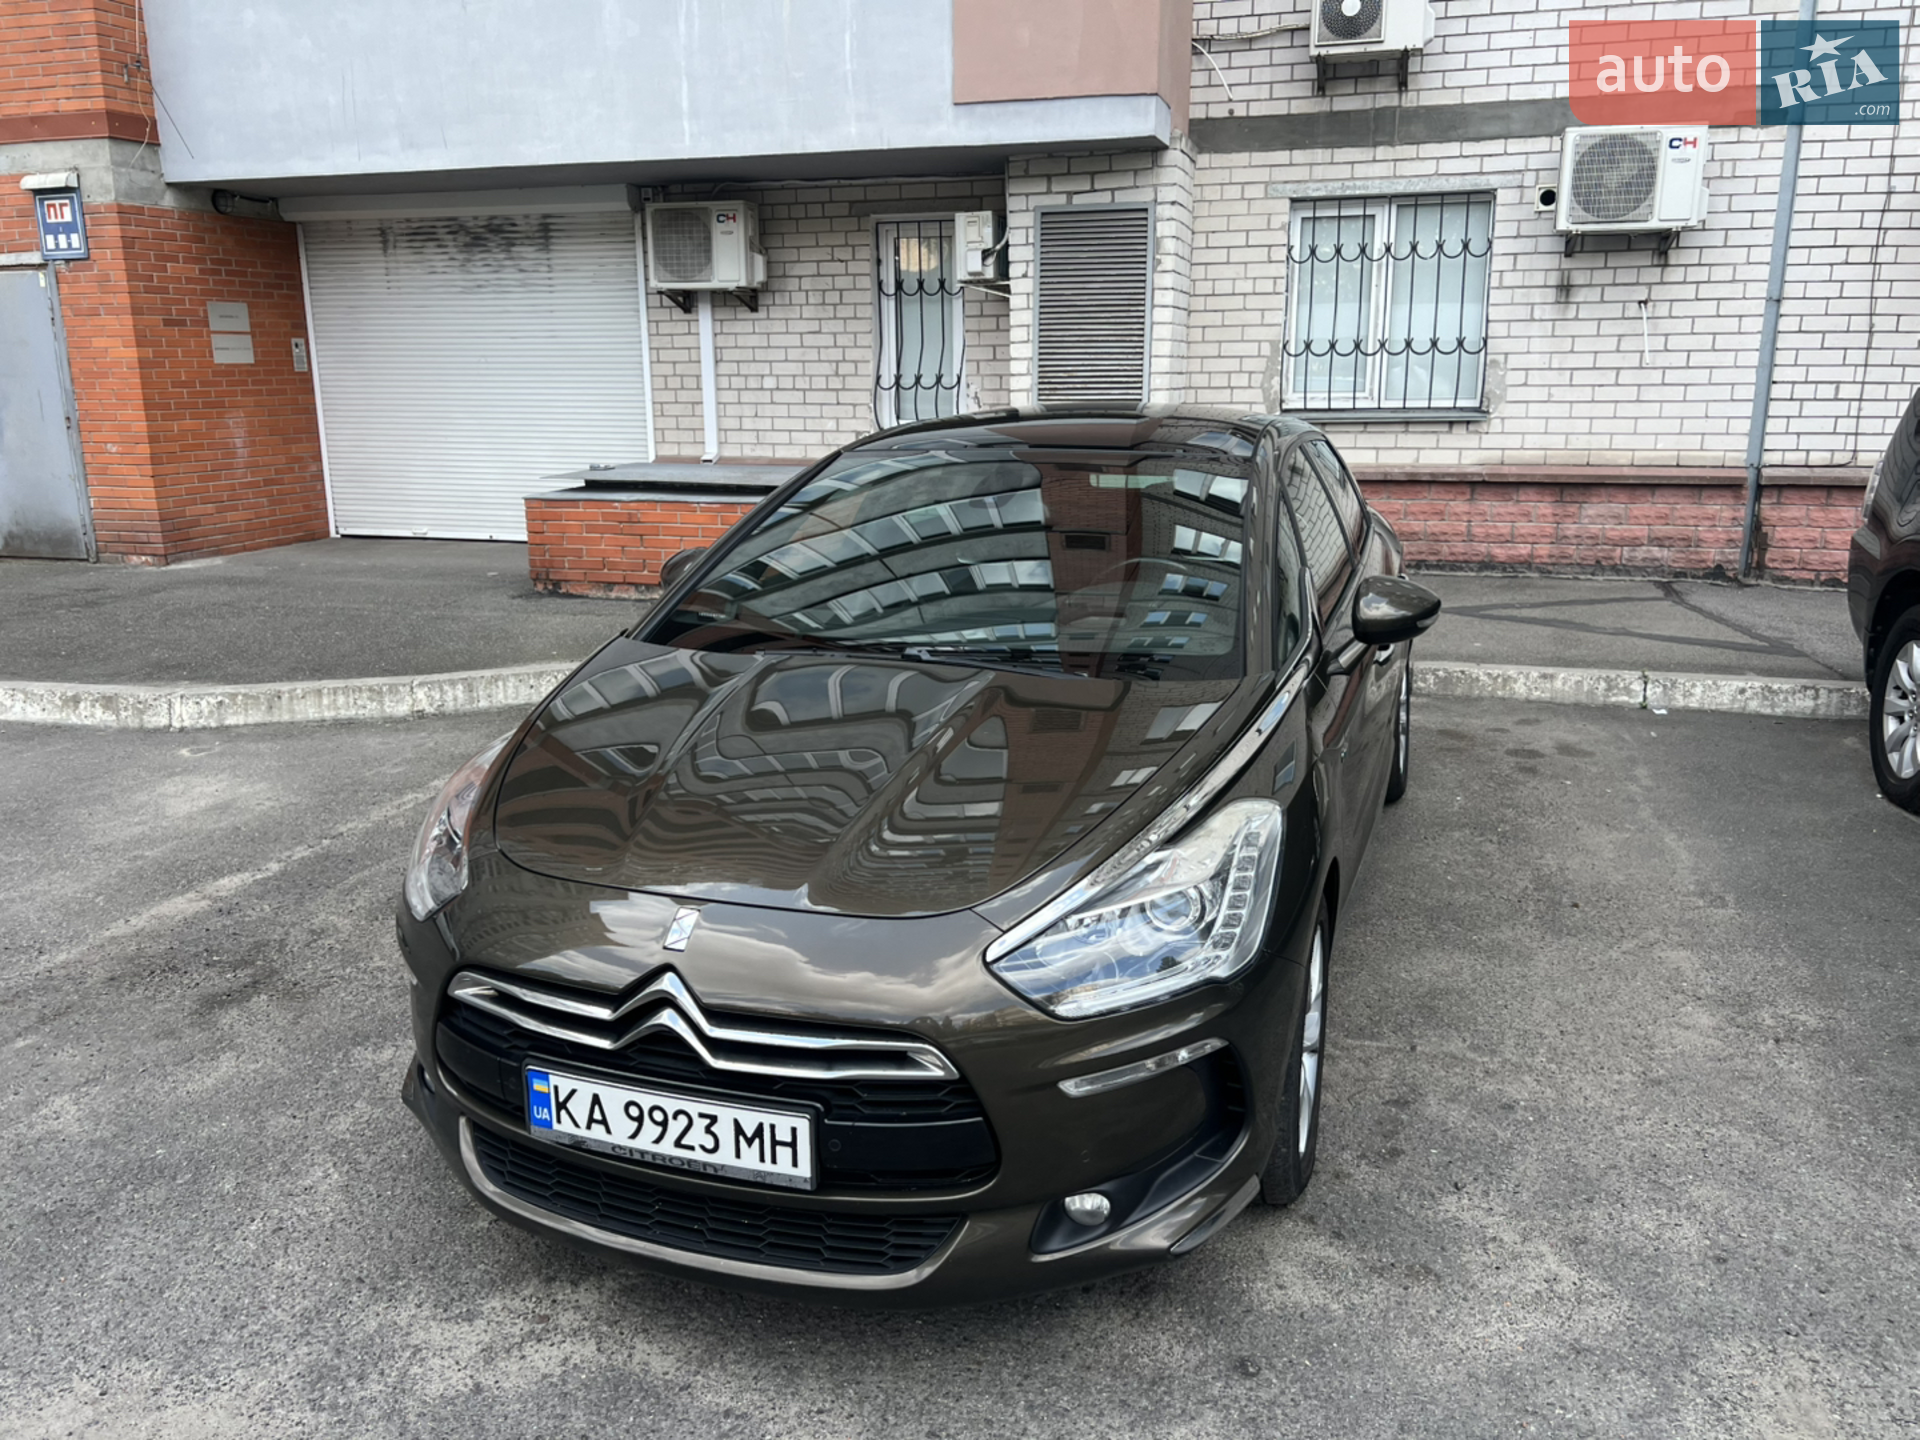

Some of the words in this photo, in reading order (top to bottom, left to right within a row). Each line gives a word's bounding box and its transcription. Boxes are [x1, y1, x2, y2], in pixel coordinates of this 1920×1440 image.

[1668, 136, 1698, 150] CH
[46, 202, 70, 220] ПГ
[716, 212, 737, 224] CH
[533, 1104, 551, 1121] UA
[552, 1084, 613, 1135] KA
[623, 1100, 720, 1154] 9923
[733, 1116, 799, 1168] MH
